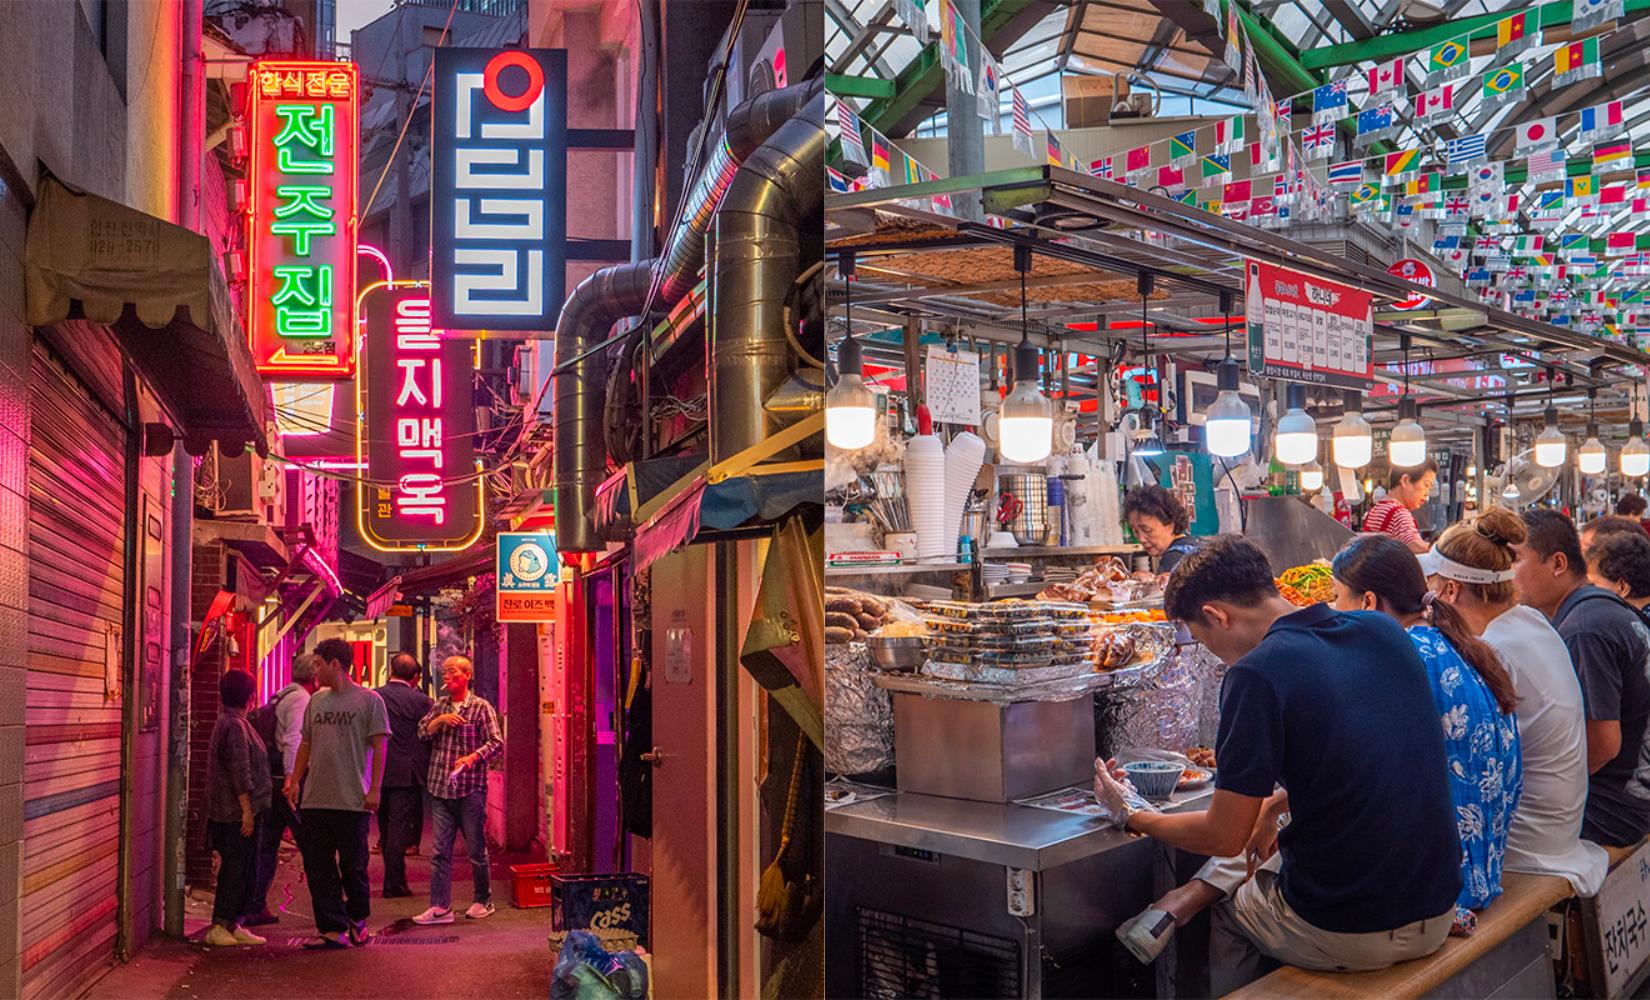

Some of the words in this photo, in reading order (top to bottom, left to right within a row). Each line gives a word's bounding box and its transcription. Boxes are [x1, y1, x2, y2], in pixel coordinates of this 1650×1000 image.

[259, 70, 350, 97] 한식전문
[271, 104, 336, 338] 전주집
[395, 299, 447, 525] 을지맥옥
[503, 599, 523, 610] 진로
[314, 711, 357, 726] ARMY
[1604, 899, 1648, 976] 잔치국수
